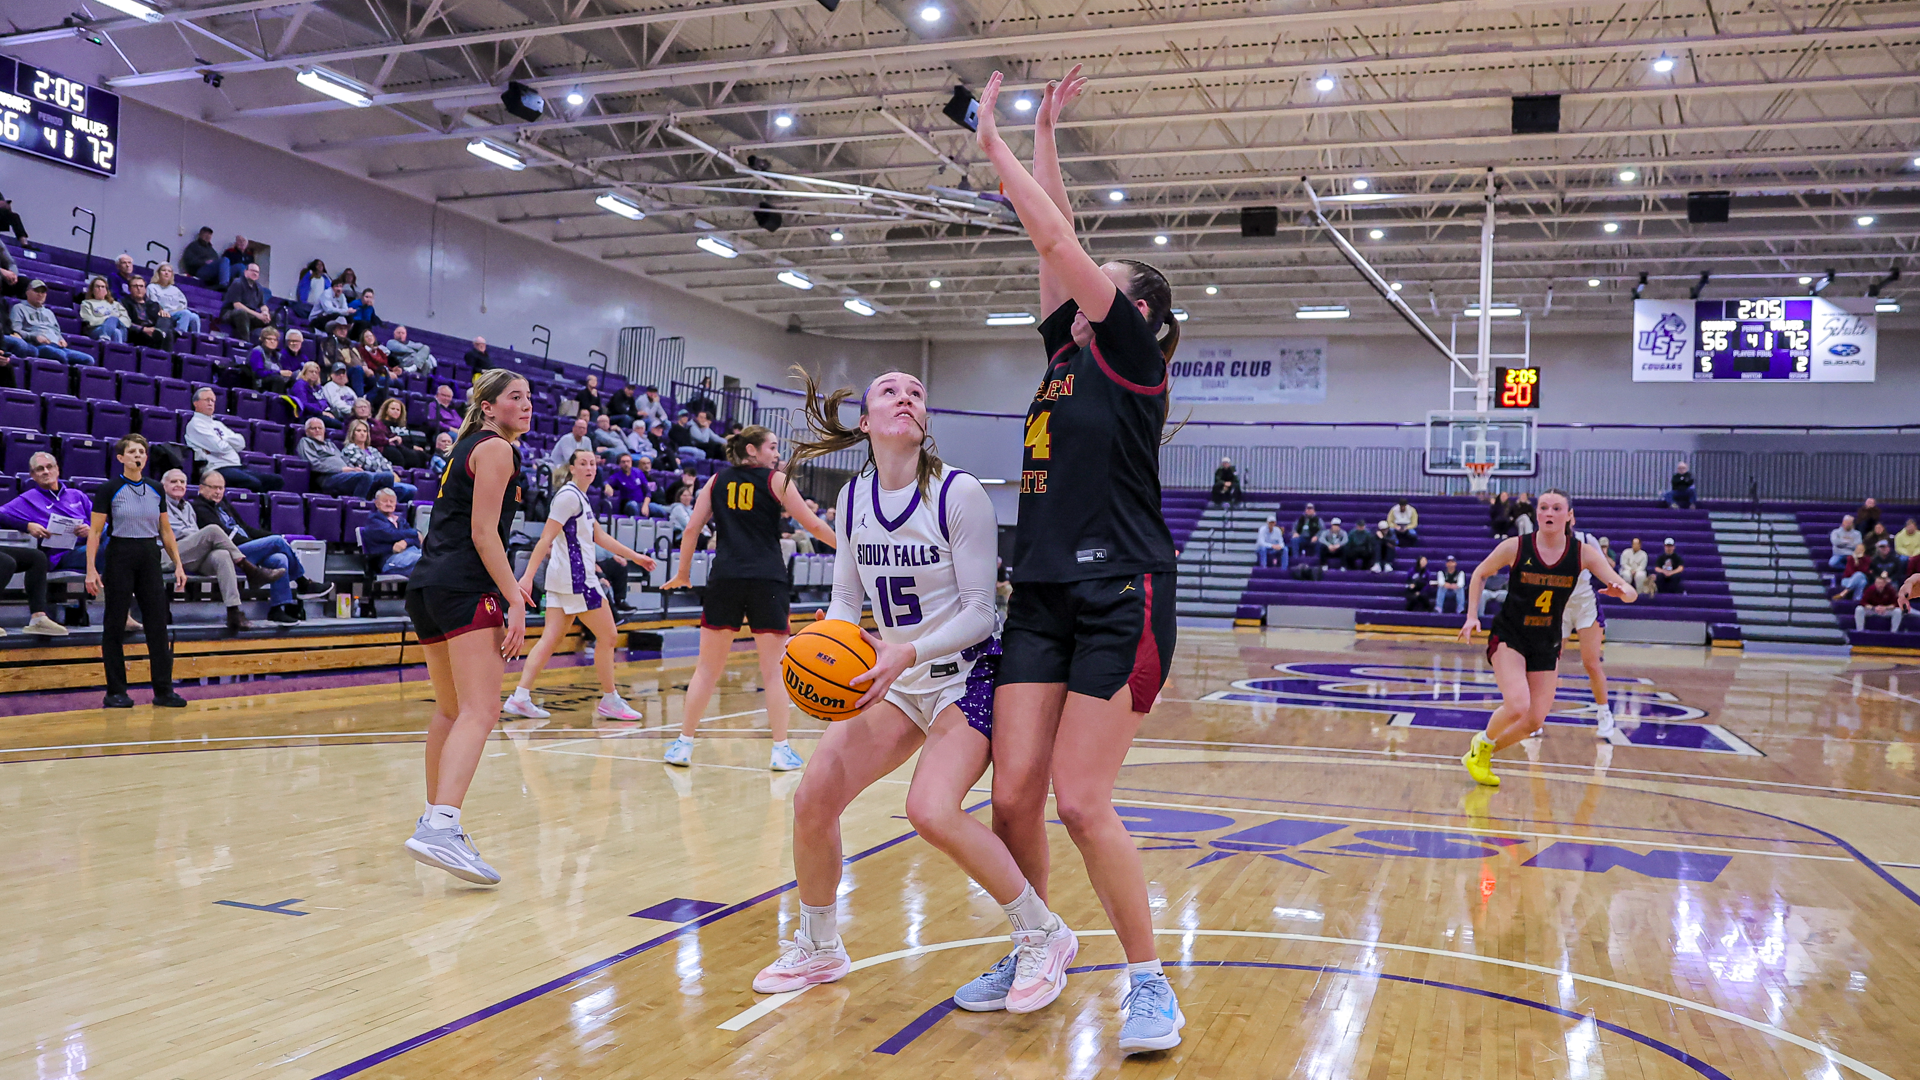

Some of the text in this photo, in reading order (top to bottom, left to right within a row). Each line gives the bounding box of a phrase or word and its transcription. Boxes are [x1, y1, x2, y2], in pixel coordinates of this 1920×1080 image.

[33, 70, 85, 113] 2:05
[86, 135, 114, 169] 72
[1738, 299, 1782, 319] 2:05
[1638, 330, 1687, 360] USF
[1702, 330, 1728, 351] 56
[1783, 330, 1809, 350] 72
[1229, 360, 1272, 378] CLUB
[1505, 368, 1538, 385] 2:05
[1642, 362, 1683, 371] COUGARS
[1700, 356, 1713, 373] 5
[1796, 356, 1809, 373] 2
[1501, 382, 1532, 408] 20
[1019, 470, 1048, 494] TE
[726, 481, 755, 511] 10
[857, 543, 941, 567] SIOUX FALLS
[1095, 551, 1105, 559] XL
[875, 575, 923, 628] 15
[1534, 589, 1554, 614] 4
[785, 664, 846, 709] Wilson
